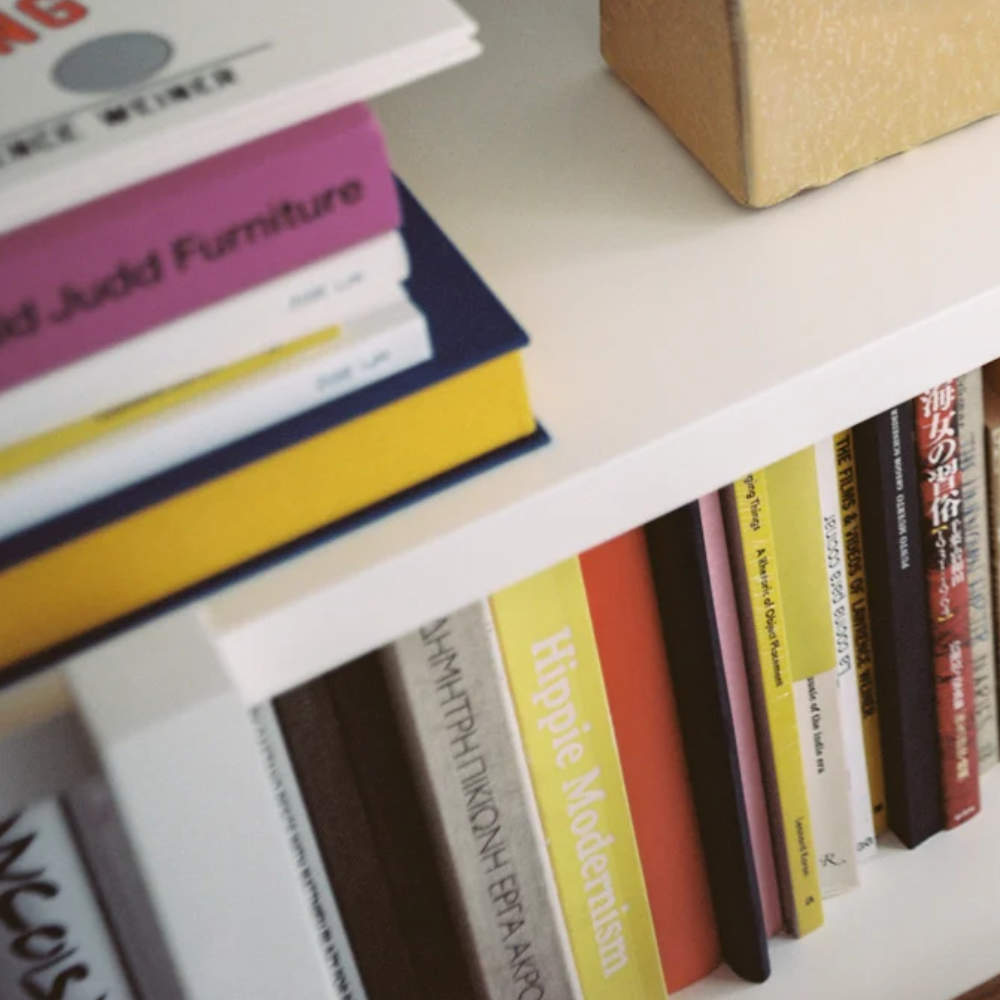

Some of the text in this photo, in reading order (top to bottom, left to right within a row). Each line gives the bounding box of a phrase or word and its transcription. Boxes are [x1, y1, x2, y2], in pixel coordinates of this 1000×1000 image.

[0, 67, 236, 172] NCE WEINER
[49, 250, 162, 323] Judd
[171, 177, 364, 273] Furniture
[836, 437, 850, 466] THE
[839, 466, 856, 510] FILMS
[749, 497, 761, 532] Things
[844, 510, 858, 525] &
[756, 548, 766, 557] A
[845, 525, 862, 577] VIDEOS
[758, 557, 773, 597] Rhetoric
[764, 597, 774, 608] of
[764, 607, 777, 639] Object
[810, 702, 820, 713] of
[811, 713, 822, 731] the
[530, 624, 631, 980] Hippie Modernism
